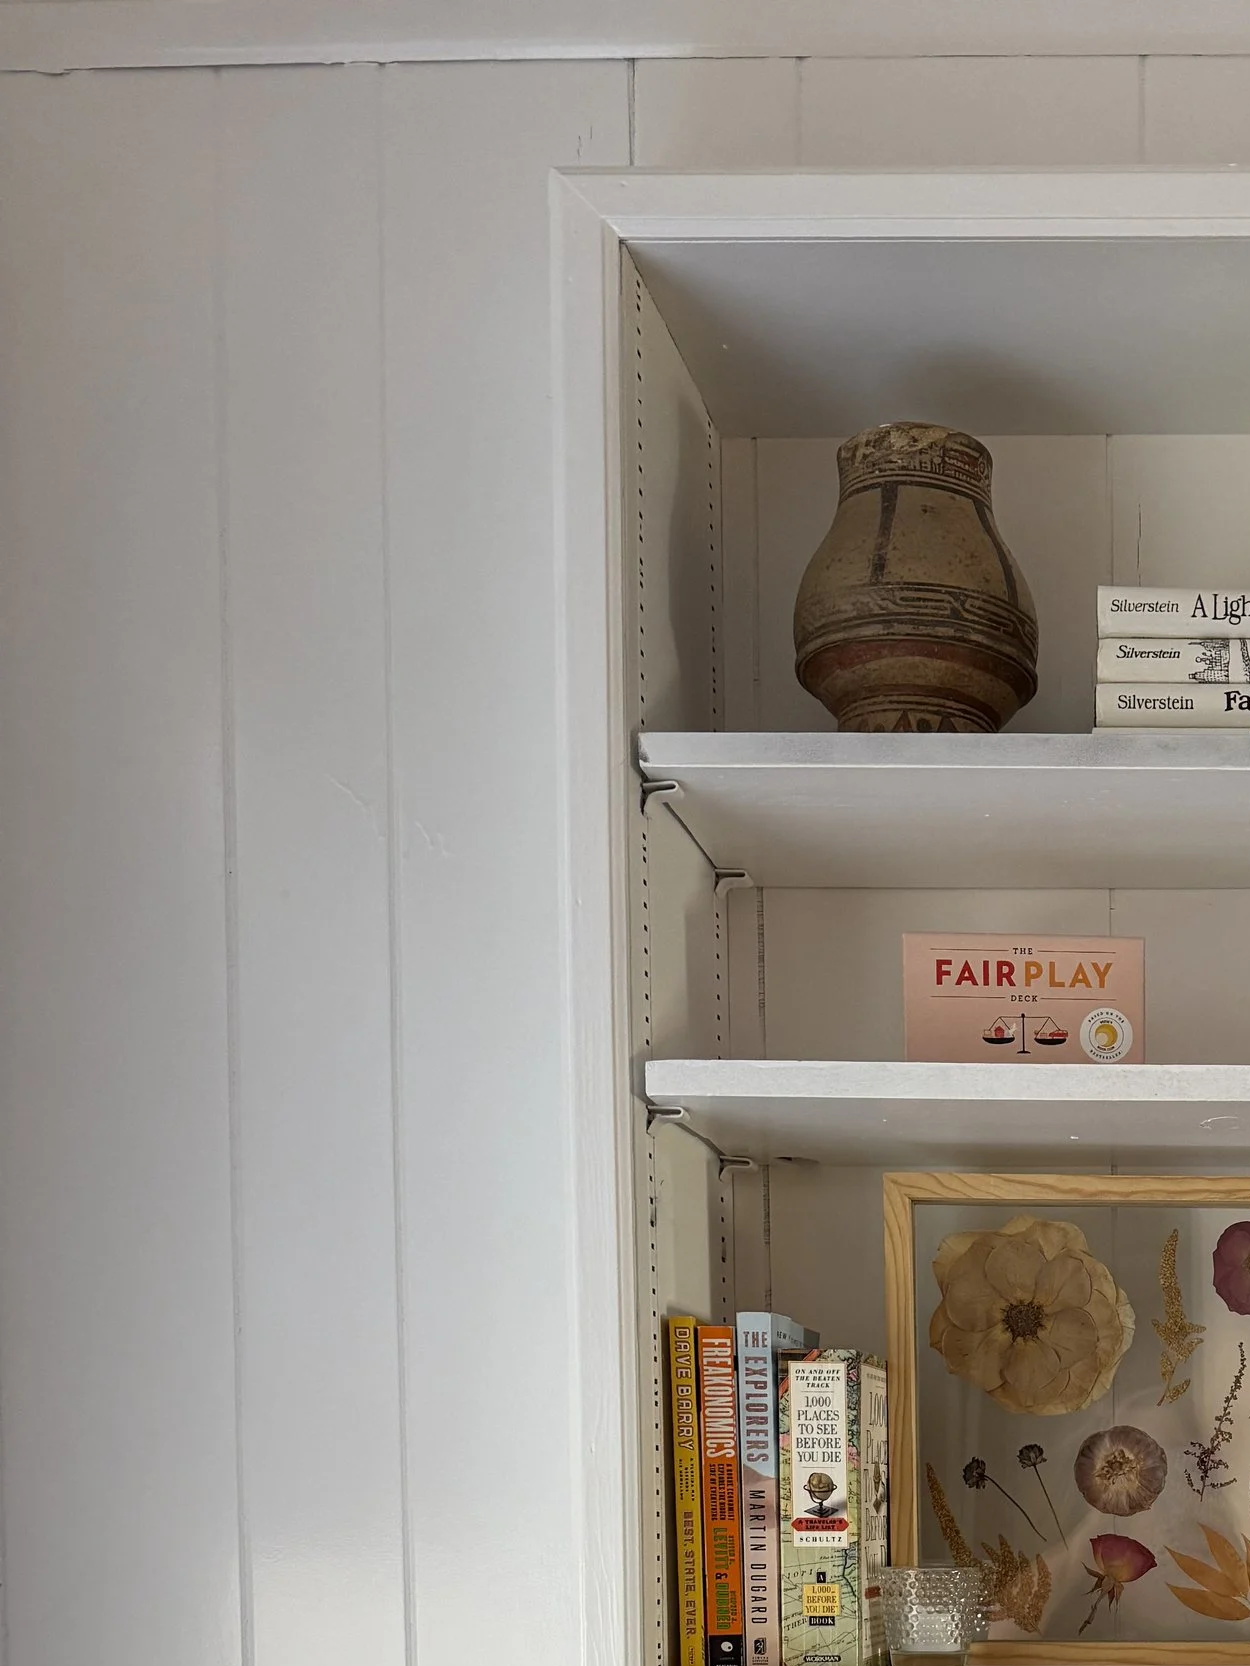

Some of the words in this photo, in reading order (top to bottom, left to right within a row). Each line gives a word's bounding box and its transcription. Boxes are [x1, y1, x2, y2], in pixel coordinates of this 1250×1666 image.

[1116, 645, 1180, 660] Silverstein
[1118, 694, 1194, 710] Silverstein
[935, 959, 1016, 987] FAIR
[1024, 961, 1113, 988] PLAY
[1010, 995, 1038, 1003] DECK
[674, 1327, 690, 1379] DAVE
[702, 1338, 737, 1458] FREAKONOMICS
[676, 1385, 694, 1451] BARRY
[797, 1410, 839, 1421] PLACES
[798, 1424, 814, 1434] TO
[817, 1424, 837, 1434] SEE
[796, 1438, 841, 1448] BEFORE
[797, 1451, 818, 1462] YOU
[822, 1451, 841, 1462] DIE
[749, 1490, 766, 1551] MARTIN
[750, 1563, 767, 1624] DUGARD
